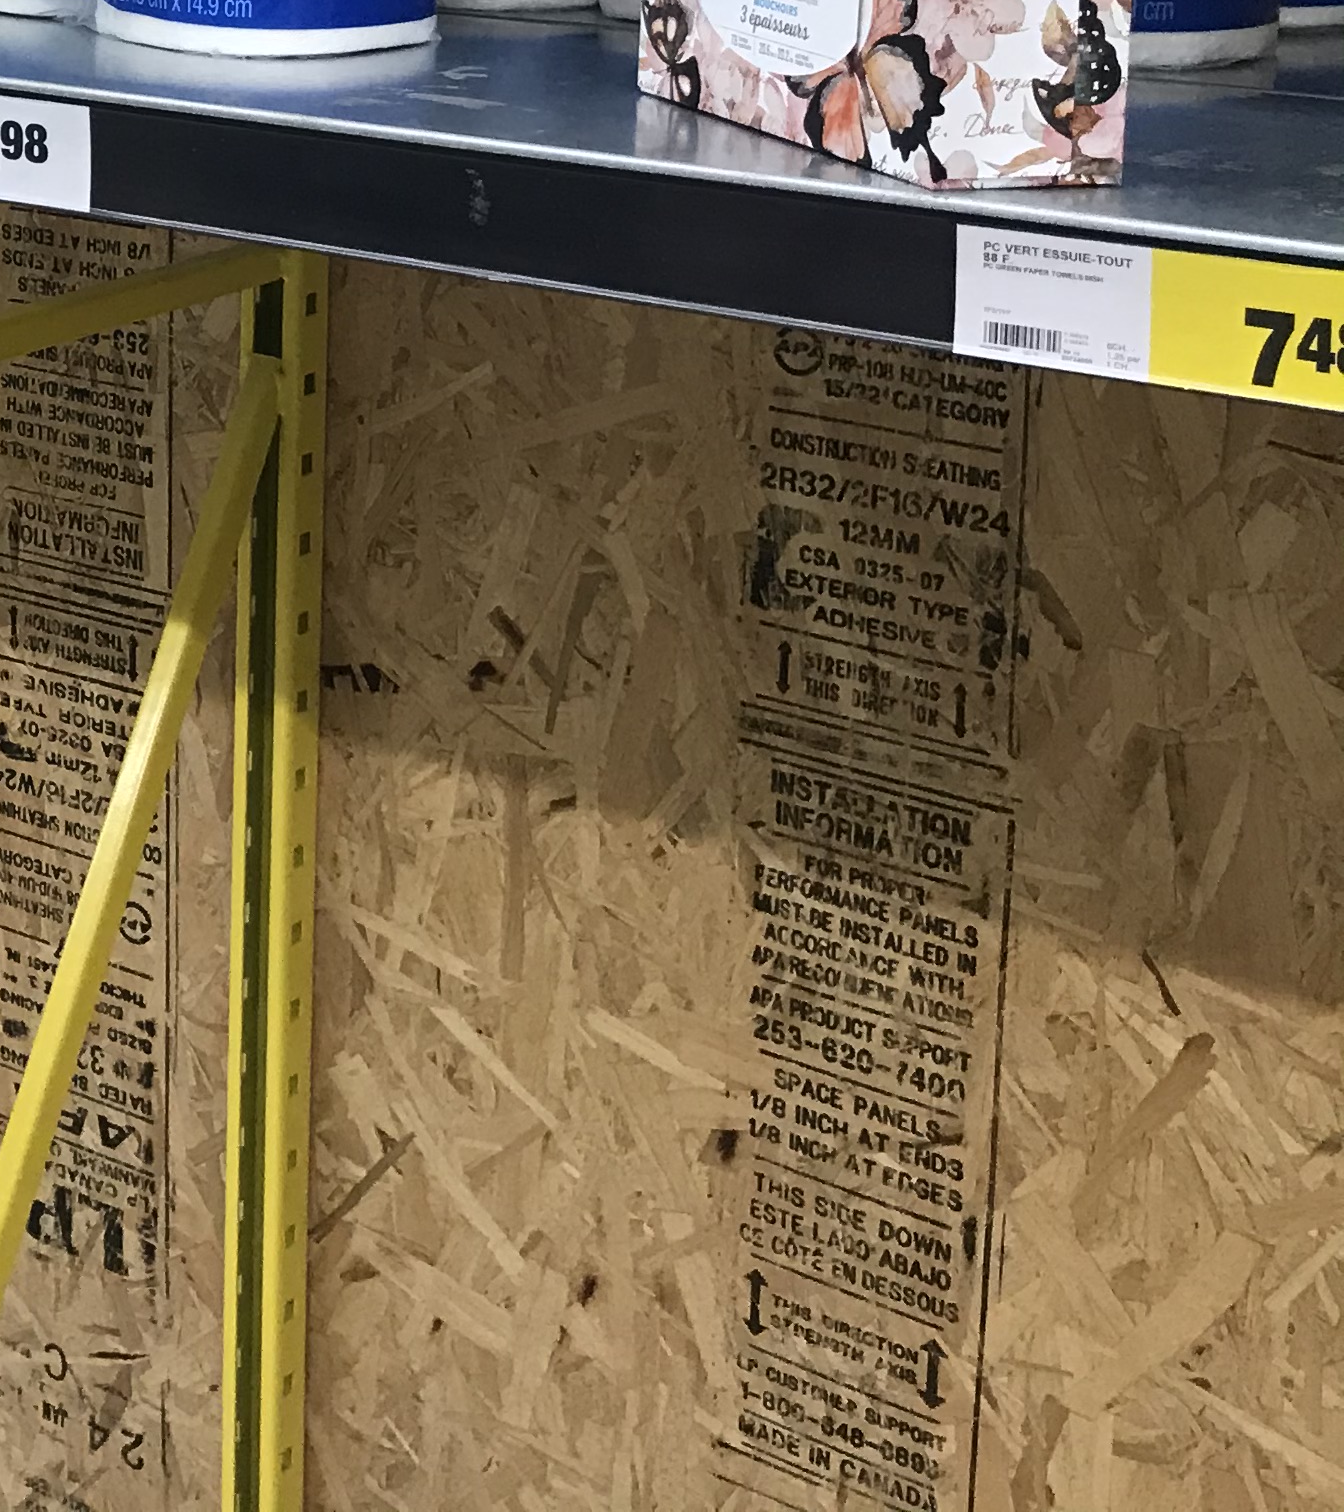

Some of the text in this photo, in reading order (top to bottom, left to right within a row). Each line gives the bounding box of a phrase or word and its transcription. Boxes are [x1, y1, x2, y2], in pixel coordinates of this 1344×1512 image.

[224, 0, 252, 18] cm
[740, 5, 809, 41] 3 épaisseurs
[52, 256, 72, 274] AT
[984, 242, 1133, 268] PC VERT ESSUIE-TOUT
[17, 420, 153, 464] MUST BE INSTALLED
[8, 520, 143, 572] INSTALLATION
[799, 545, 840, 570] CSA
[785, 569, 969, 626] EXTERIOR TYPE
[95, 629, 124, 653] THIS
[813, 606, 937, 650] ADHESIVE
[23, 674, 123, 713] ADHESIVE
[805, 678, 840, 702] THIS
[775, 800, 962, 875] INFORMATION
[805, 854, 842, 881] FOR
[755, 864, 978, 948] PERFORMANCE PANELS
[753, 891, 977, 976] MUST BE INSTALLED IN
[749, 1089, 890, 1153] 1/8 INCH AT
[774, 1068, 940, 1143] SPACE PANELS
[749, 1117, 962, 1212] 1/8 INCH AT EDGES
[753, 1171, 951, 1263] THIS DOWN
[750, 1198, 951, 1291] ESTE ABAJO
[740, 1223, 960, 1324] CE EN DESSOUS
[771, 1294, 811, 1321] THIS
[738, 1414, 938, 1510] MADE IN CANADA
